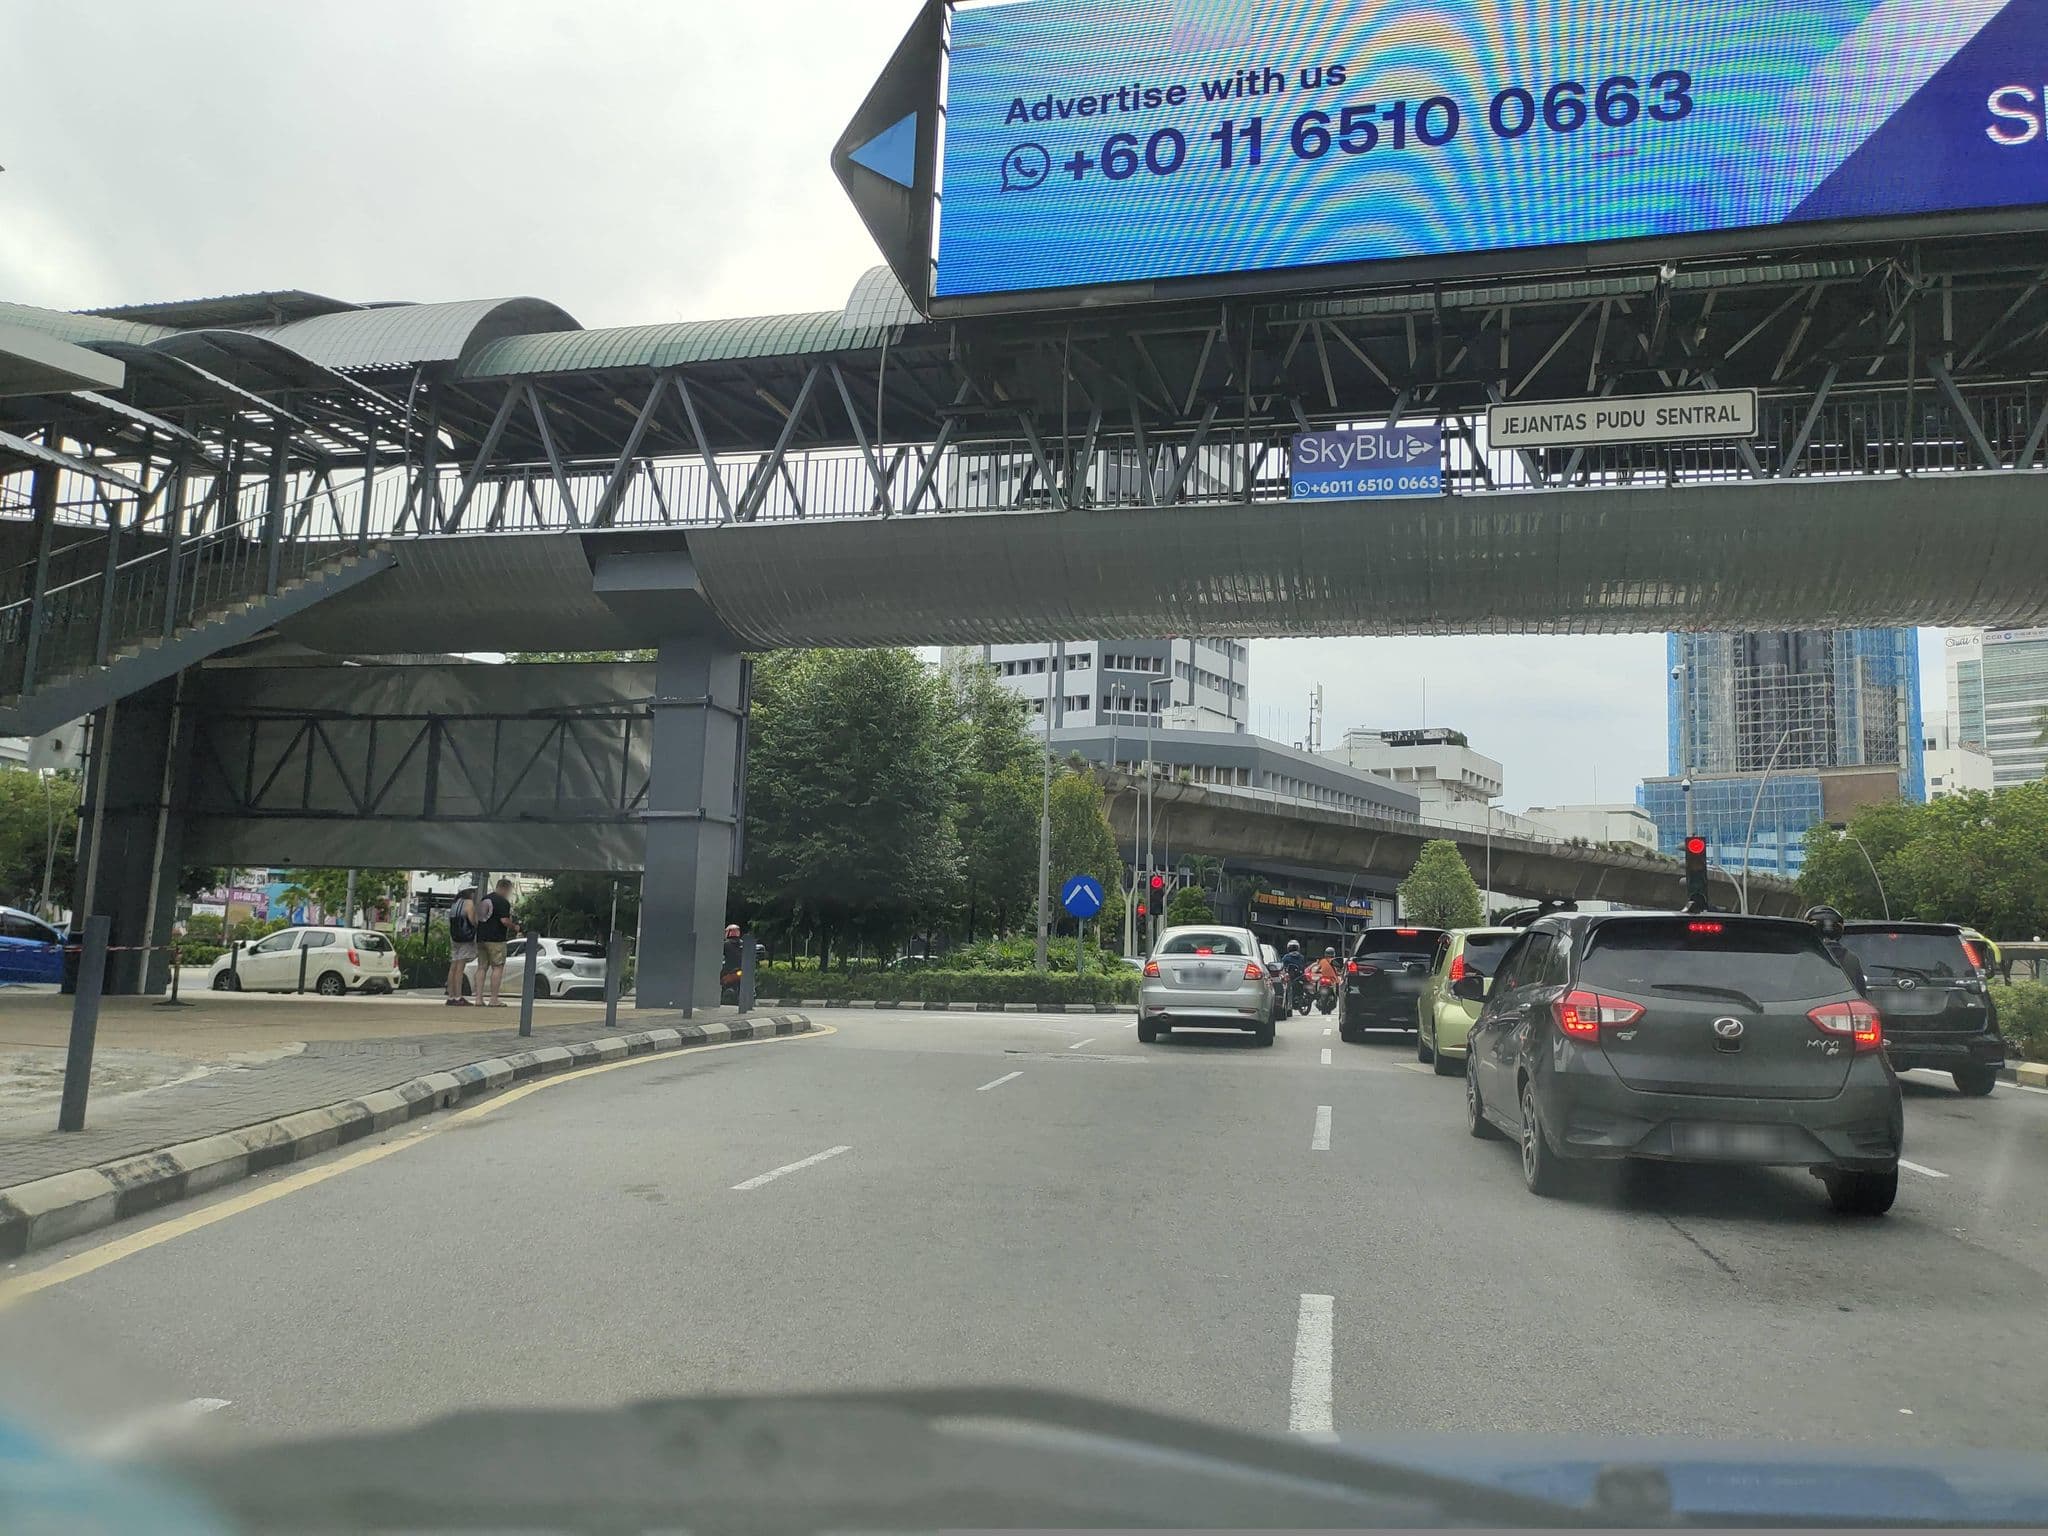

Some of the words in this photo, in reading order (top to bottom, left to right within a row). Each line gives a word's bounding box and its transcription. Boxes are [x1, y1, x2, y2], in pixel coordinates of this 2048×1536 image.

[1004, 82, 1188, 124] Advertise
[1200, 66, 1285, 102] with
[1300, 63, 1347, 89] us
[1985, 85, 2048, 145] S
[1063, 127, 1187, 181] +60
[1210, 116, 1263, 169] 11
[1290, 96, 1461, 160] 6510
[1488, 69, 1694, 139] 0663
[1501, 413, 1587, 435] JEJANTAS
[1596, 409, 1646, 430] PUDU
[1655, 404, 1741, 426] SENTRAL
[1310, 480, 1354, 494] +6011
[1357, 478, 1394, 492] 6510
[1398, 475, 1439, 490] 0663
[1972, 634, 1980, 645] 6
